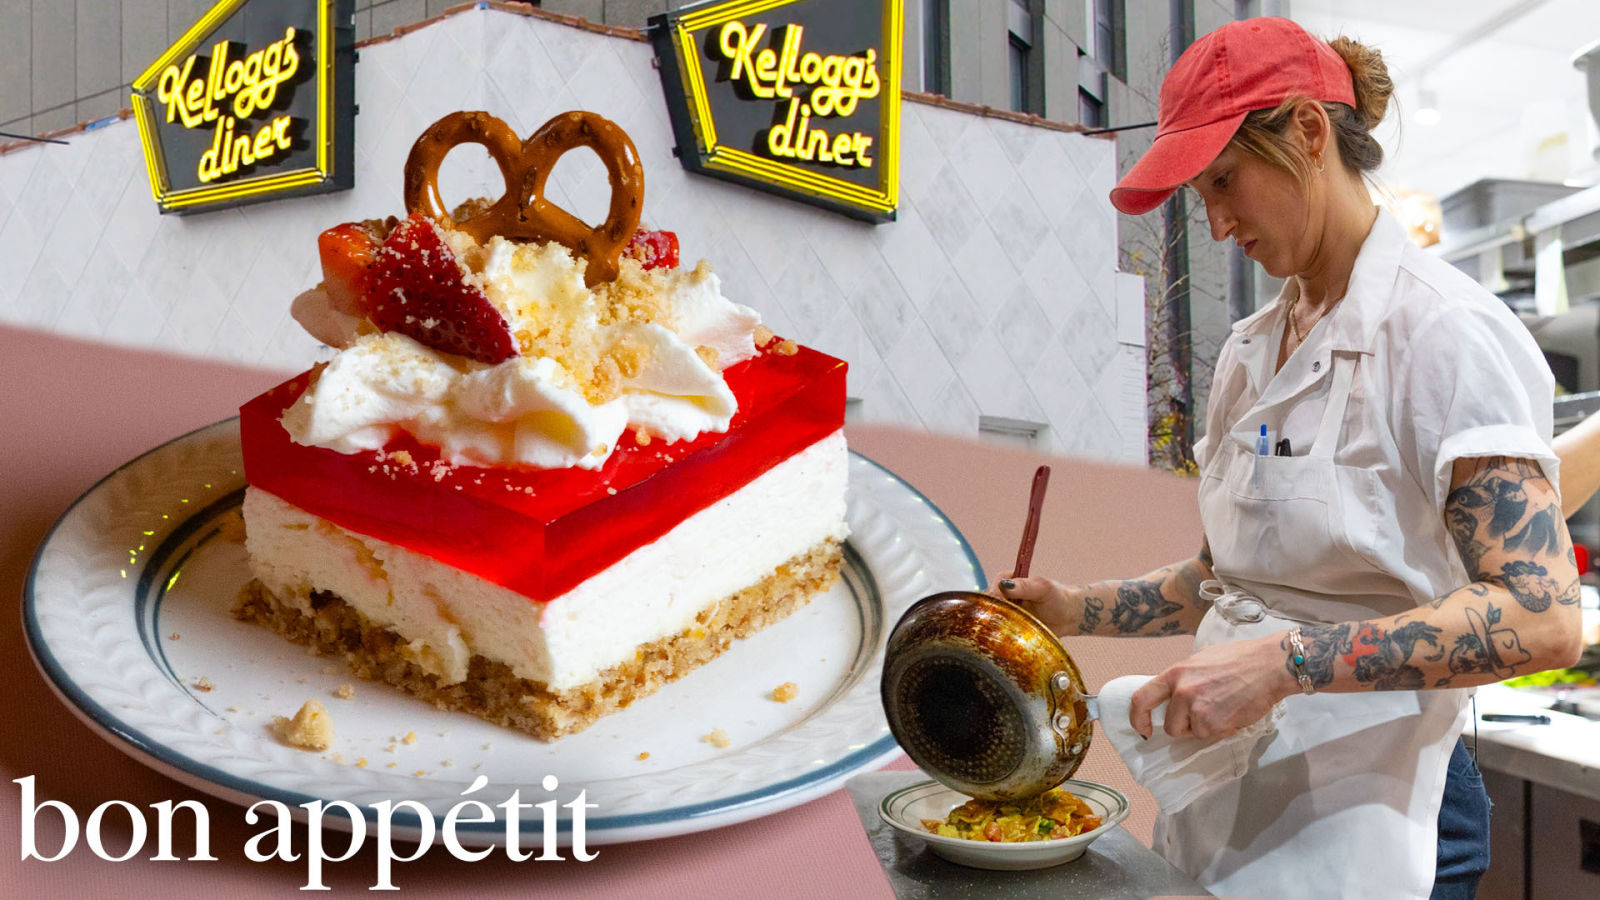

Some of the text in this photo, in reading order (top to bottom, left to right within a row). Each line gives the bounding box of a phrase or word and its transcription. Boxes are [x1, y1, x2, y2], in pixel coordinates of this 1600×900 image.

[158, 27, 299, 128] Kellogg's
[720, 21, 880, 116] Kellogg's
[198, 116, 291, 182] diner
[768, 98, 872, 167] diner
